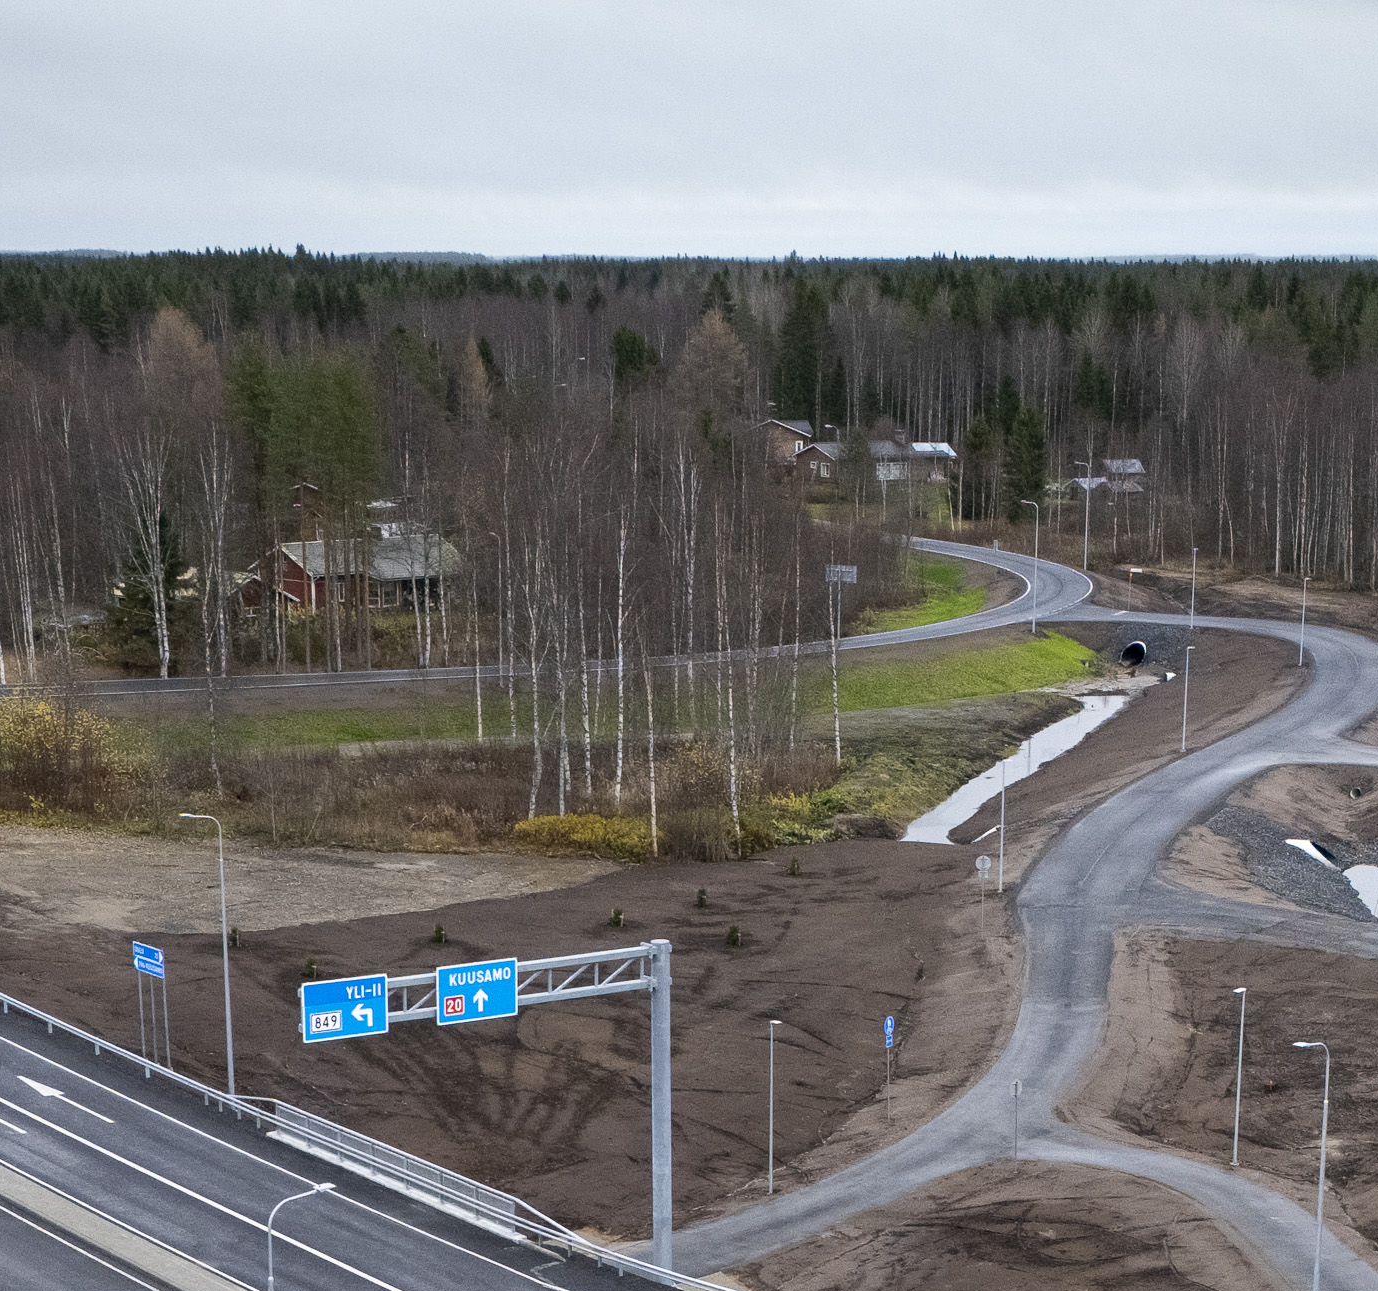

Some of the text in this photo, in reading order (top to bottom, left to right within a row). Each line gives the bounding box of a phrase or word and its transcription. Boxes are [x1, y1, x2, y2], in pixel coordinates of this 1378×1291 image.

[449, 967, 511, 986] KUUSAMO
[346, 983, 381, 999] YLI-II
[447, 999, 461, 1012] 20
[315, 1015, 337, 1028] 849
